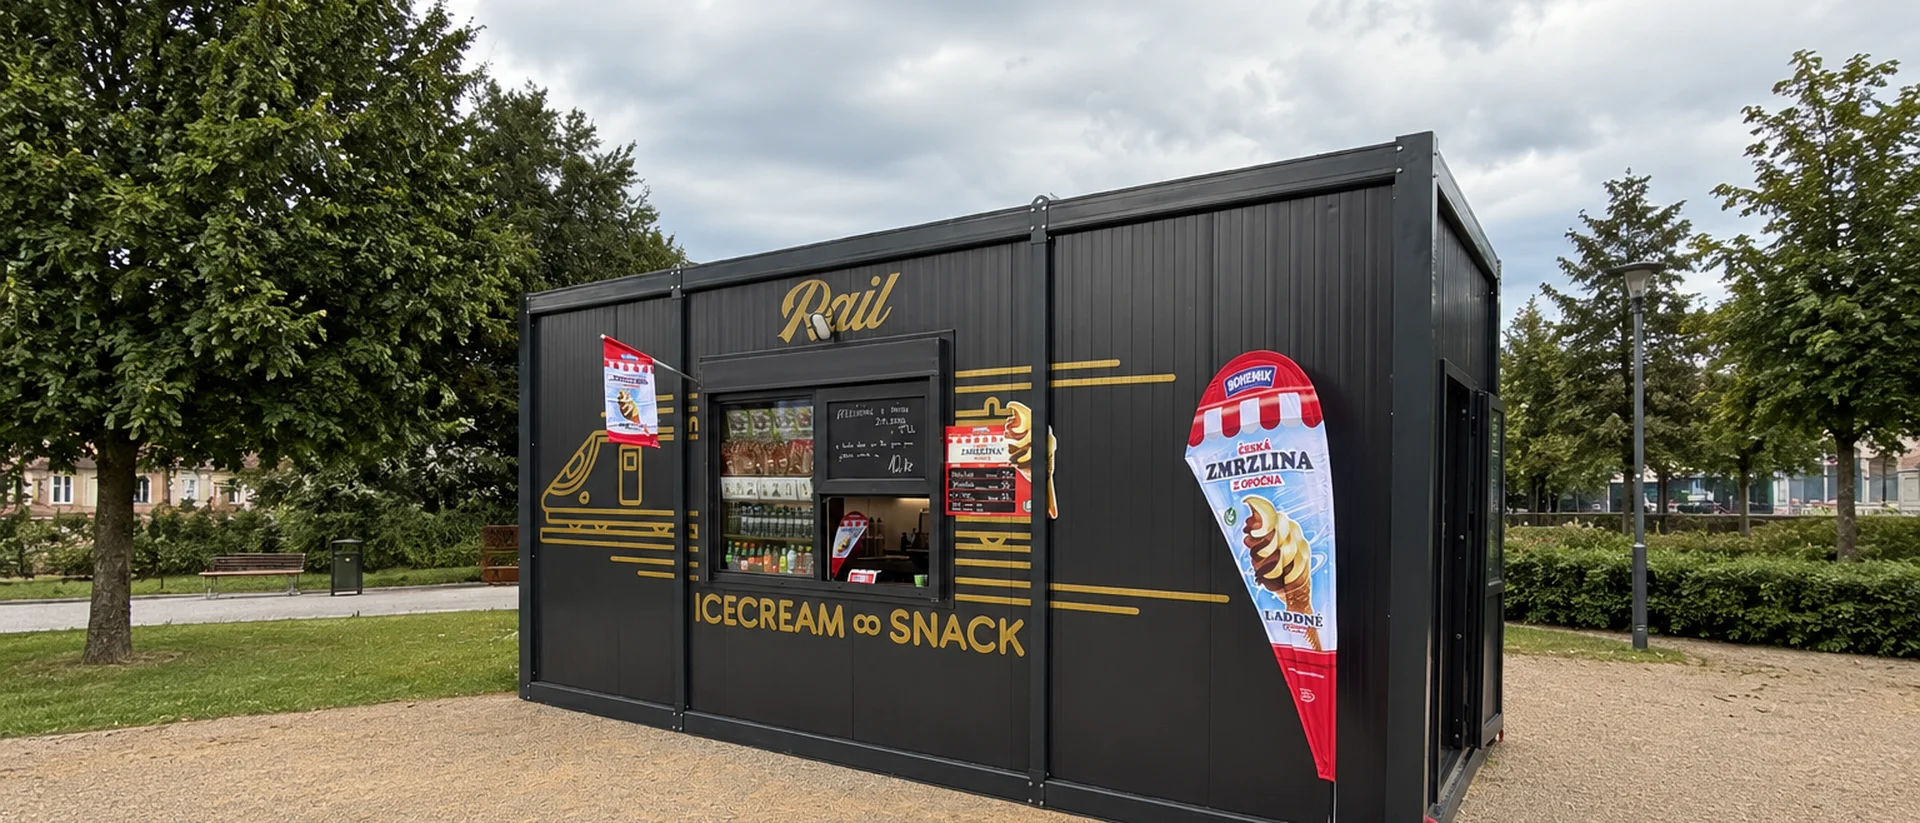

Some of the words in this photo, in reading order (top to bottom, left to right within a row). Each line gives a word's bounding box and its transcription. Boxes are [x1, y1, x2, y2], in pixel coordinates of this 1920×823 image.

[777, 272, 900, 343] Rail
[1227, 370, 1272, 391] BOHEMIX
[1238, 439, 1271, 454] ČESKÁ
[1206, 451, 1314, 480] ZMRZLINA
[1241, 475, 1282, 489] OPOČNA
[694, 592, 845, 638] ICECREAM
[889, 608, 1025, 657] SNACK
